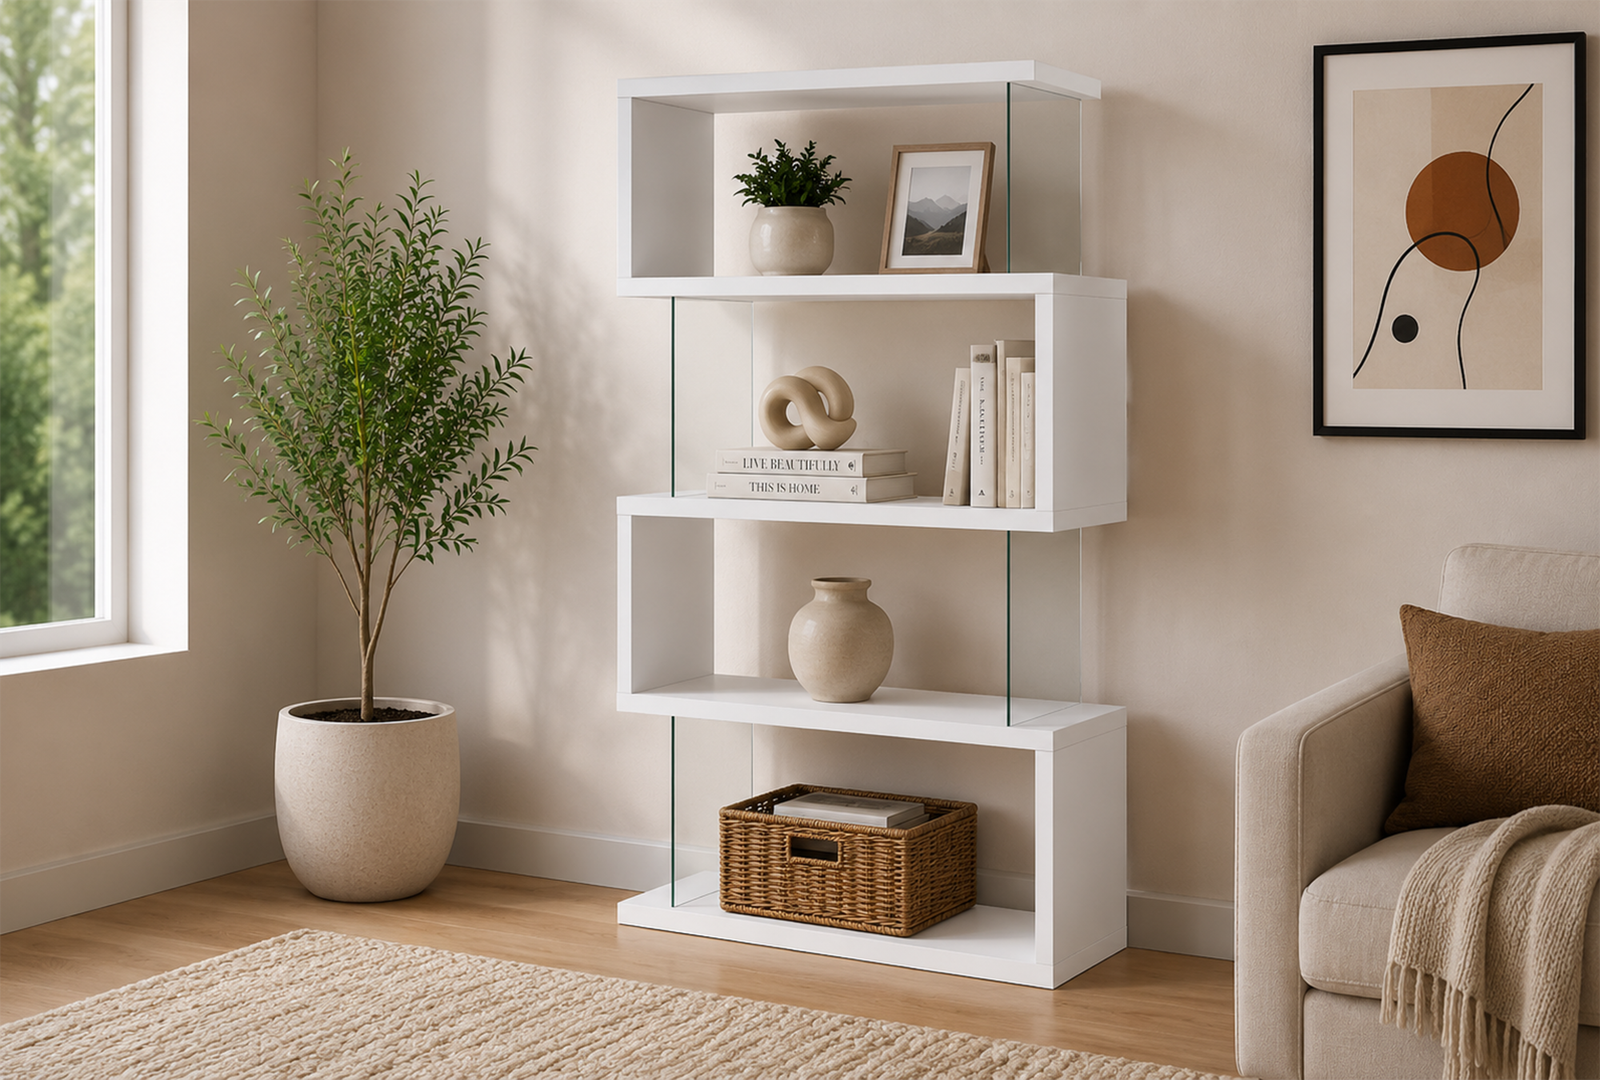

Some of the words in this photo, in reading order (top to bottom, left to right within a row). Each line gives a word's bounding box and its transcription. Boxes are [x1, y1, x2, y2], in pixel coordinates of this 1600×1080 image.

[743, 458, 768, 470] LIVE
[770, 458, 840, 471] BEAUTIFULLY
[749, 481, 774, 493] THIS
[776, 482, 787, 493] IS
[788, 483, 820, 494] HOME
